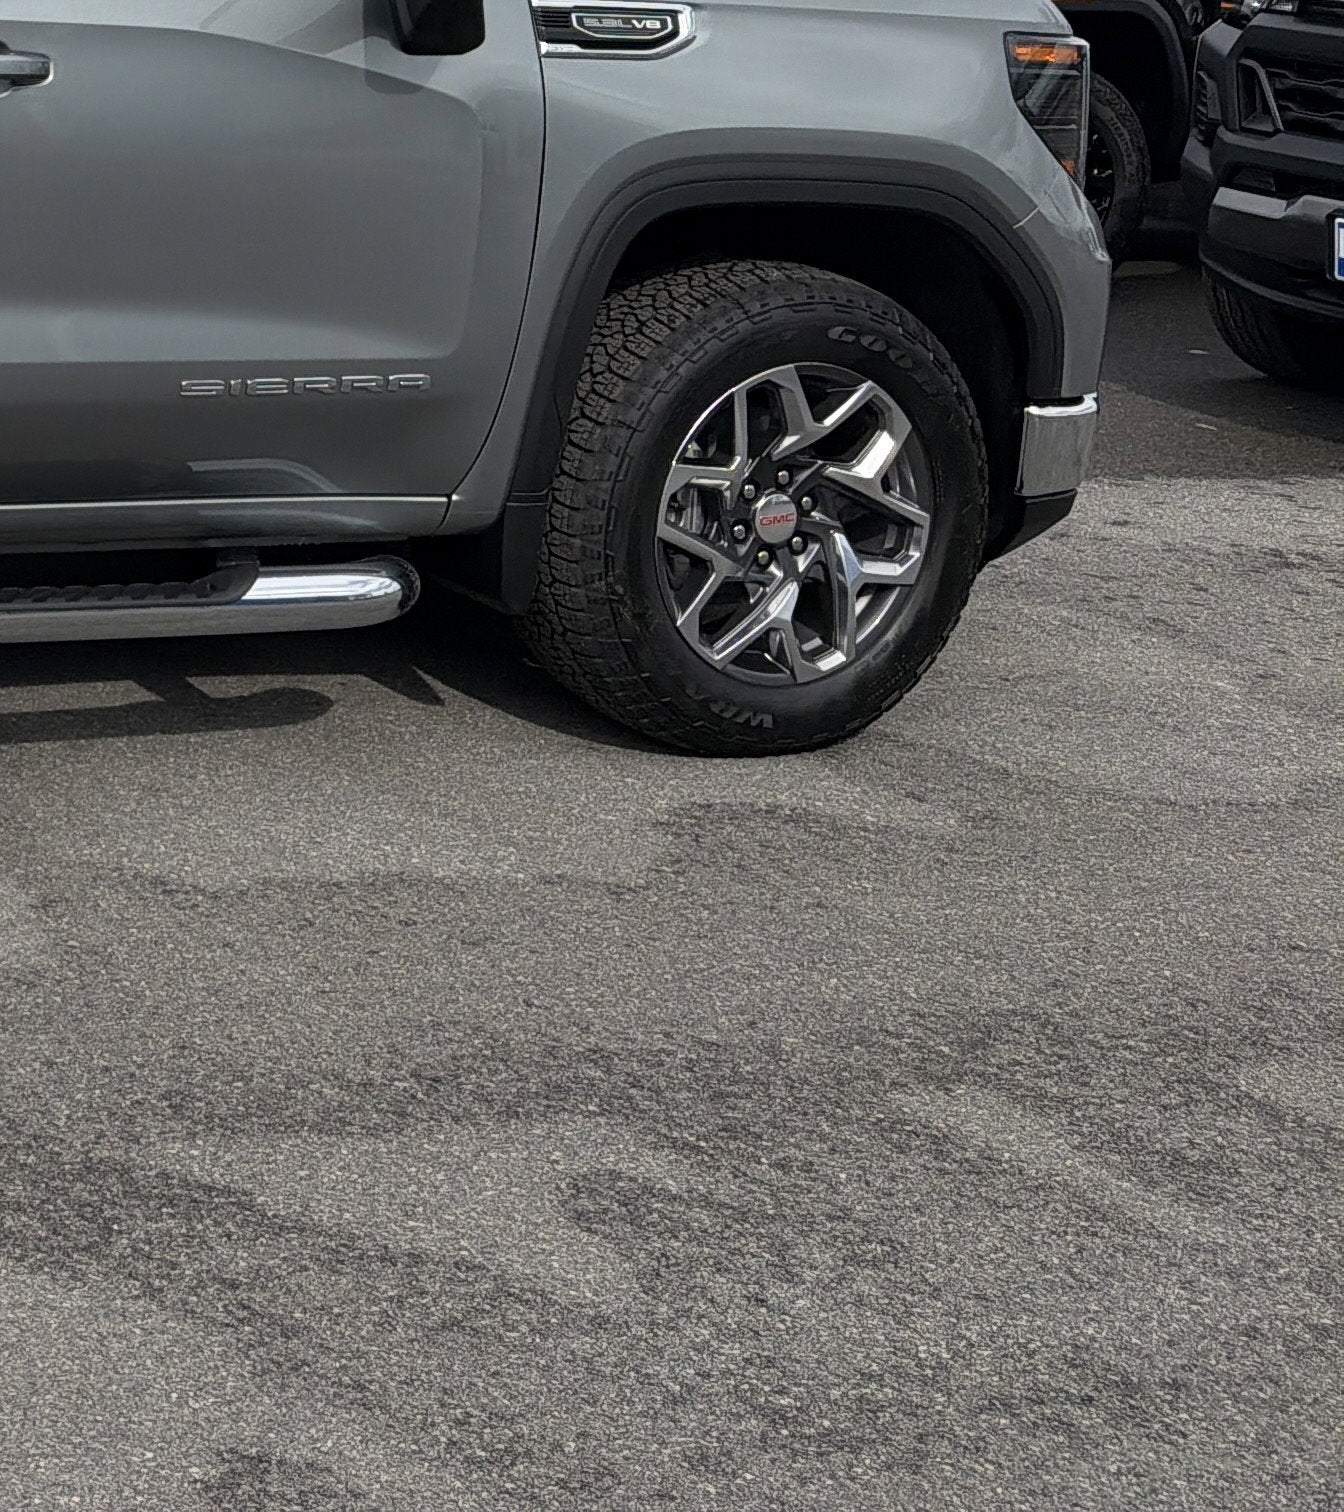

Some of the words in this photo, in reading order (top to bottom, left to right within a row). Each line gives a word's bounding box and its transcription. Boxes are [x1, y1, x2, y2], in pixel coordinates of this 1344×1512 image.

[631, 19, 661, 29] V8
[180, 373, 431, 397] SIERRA
[759, 512, 795, 526] GMC
